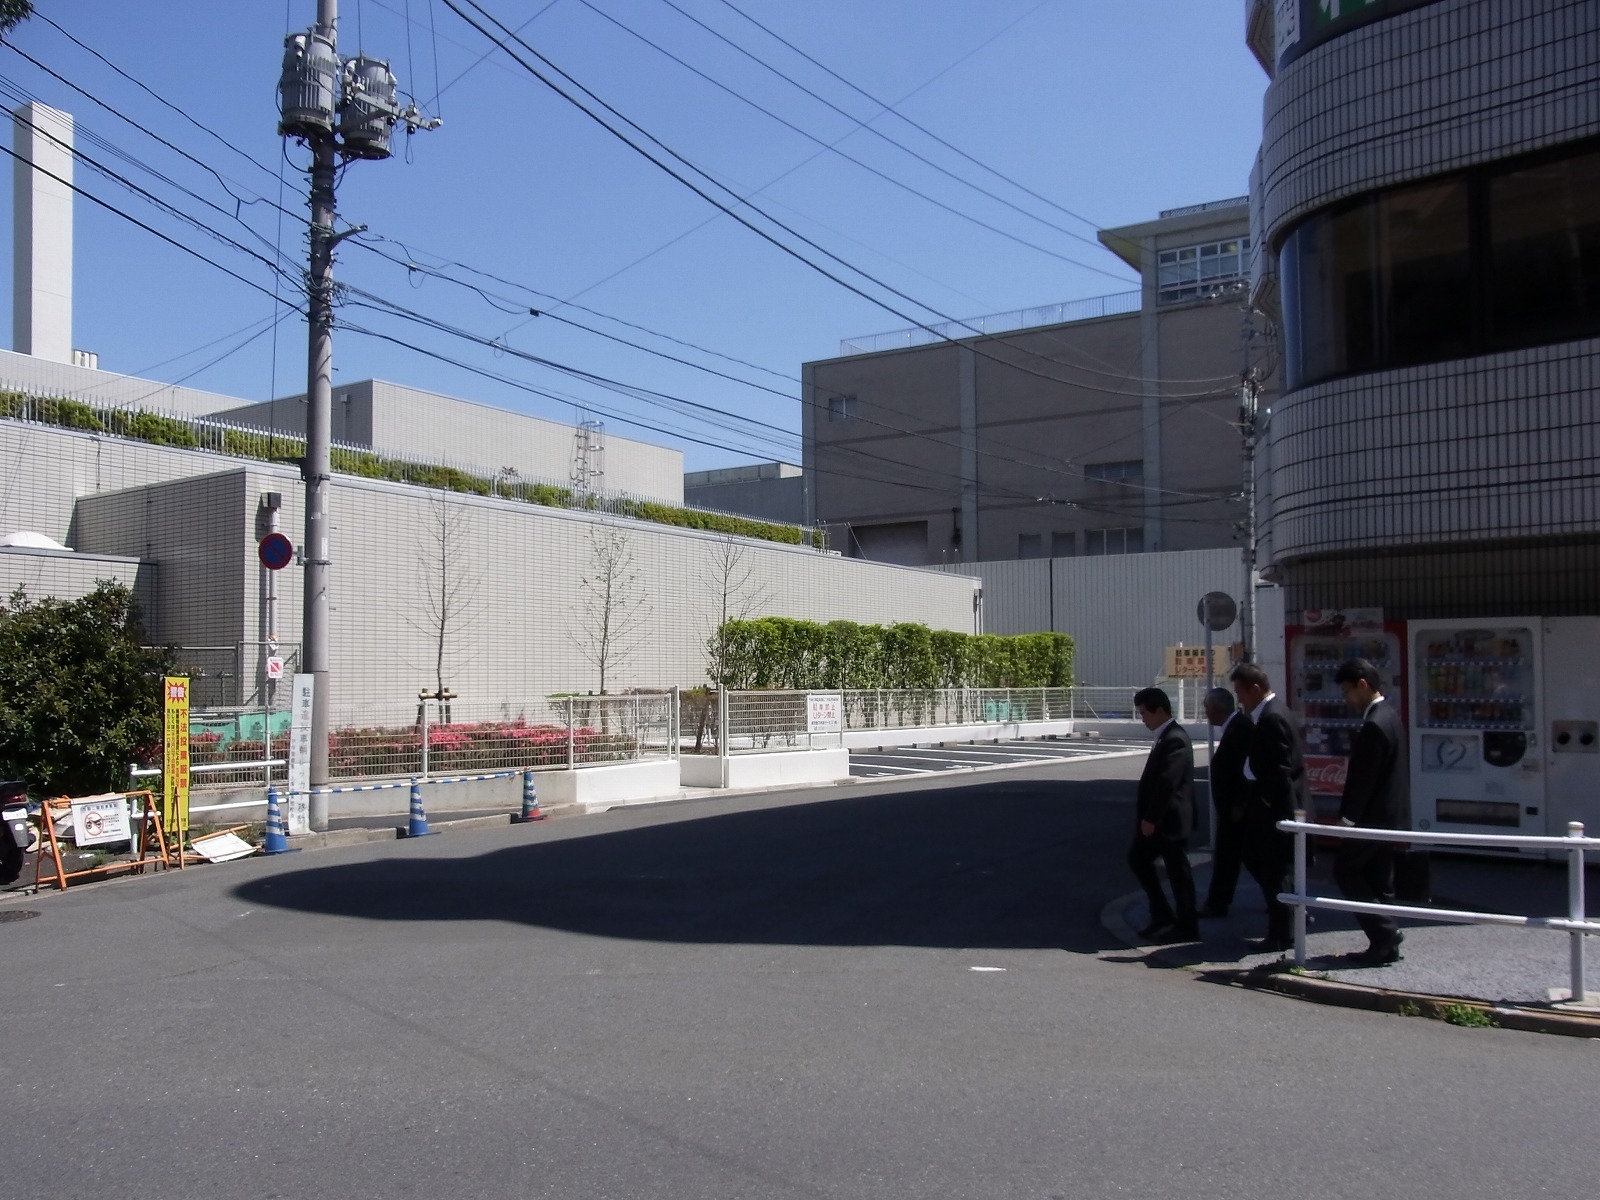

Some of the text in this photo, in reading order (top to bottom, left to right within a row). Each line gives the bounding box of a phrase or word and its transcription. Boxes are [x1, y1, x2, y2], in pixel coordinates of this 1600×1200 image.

[180, 708, 188, 789] 不法投棄厳禁
